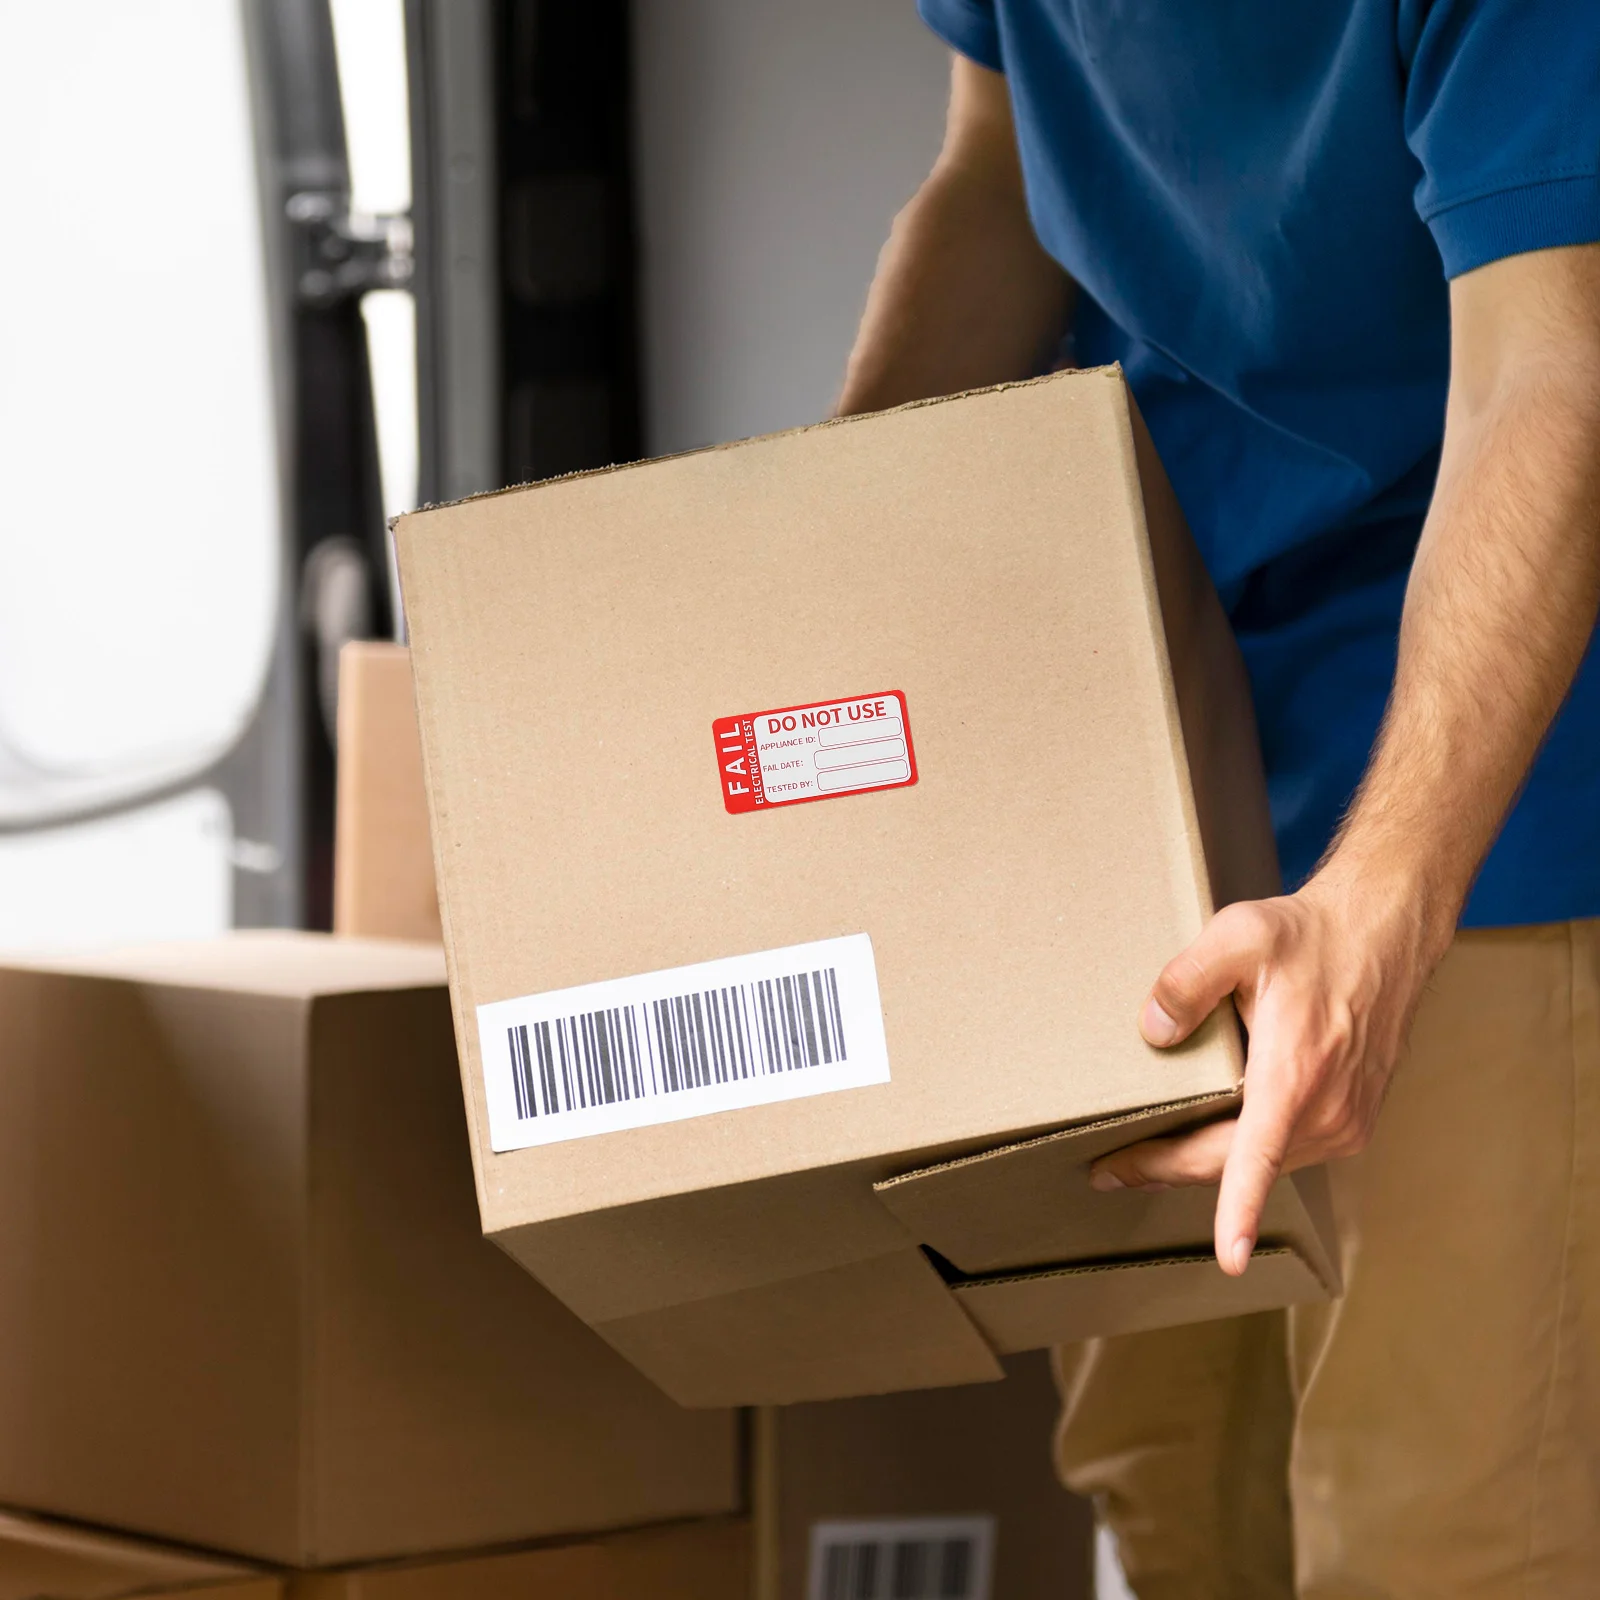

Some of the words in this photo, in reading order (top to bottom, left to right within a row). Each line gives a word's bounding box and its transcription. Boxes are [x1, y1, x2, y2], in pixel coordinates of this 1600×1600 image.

[768, 715, 797, 734] DO
[801, 708, 842, 729] NOT
[847, 701, 887, 721] USE
[742, 719, 755, 744] TEST
[760, 737, 803, 751] APPLIANCE
[805, 736, 816, 744] ID:
[720, 722, 749, 796] FAIL
[762, 763, 780, 773] FAIL
[780, 760, 804, 770] DATE:
[747, 745, 764, 804] ELECTRICAL
[766, 781, 798, 794] TESTED
[800, 780, 814, 789] BY:
